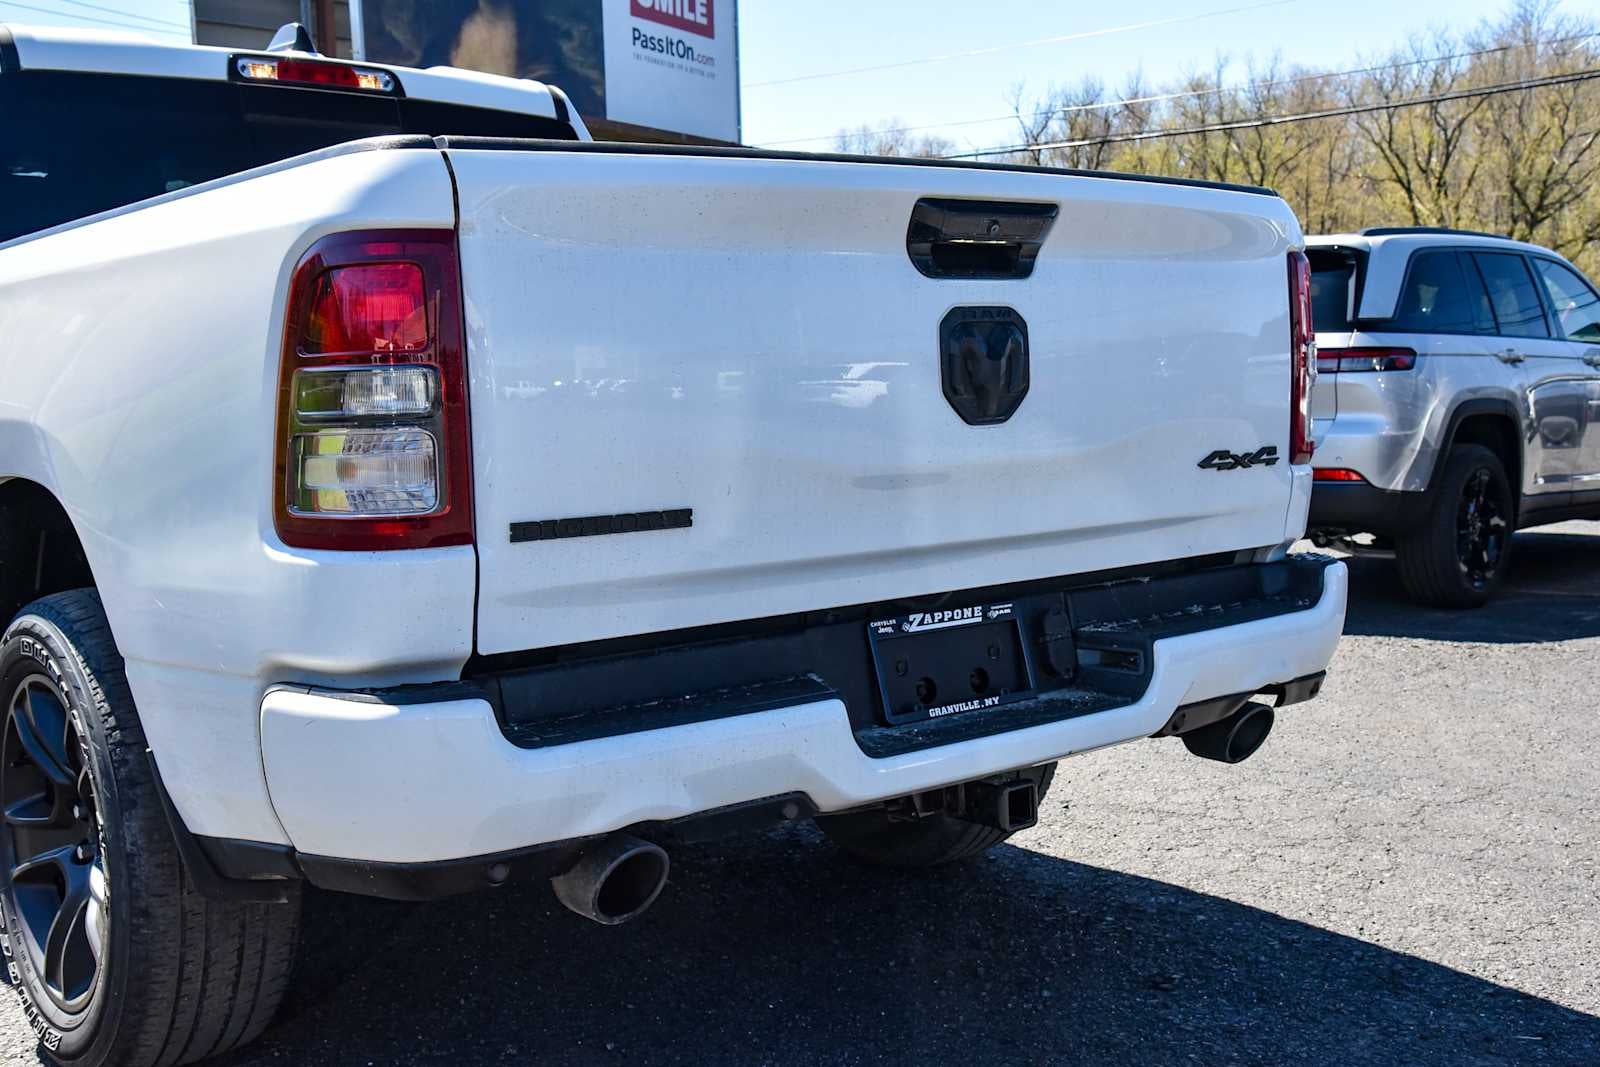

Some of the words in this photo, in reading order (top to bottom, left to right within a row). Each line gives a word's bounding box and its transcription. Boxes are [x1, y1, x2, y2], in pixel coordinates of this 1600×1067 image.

[636, 0, 708, 25] ILE
[908, 606, 982, 632] ZAPPONE
[984, 696, 999, 706] NY
